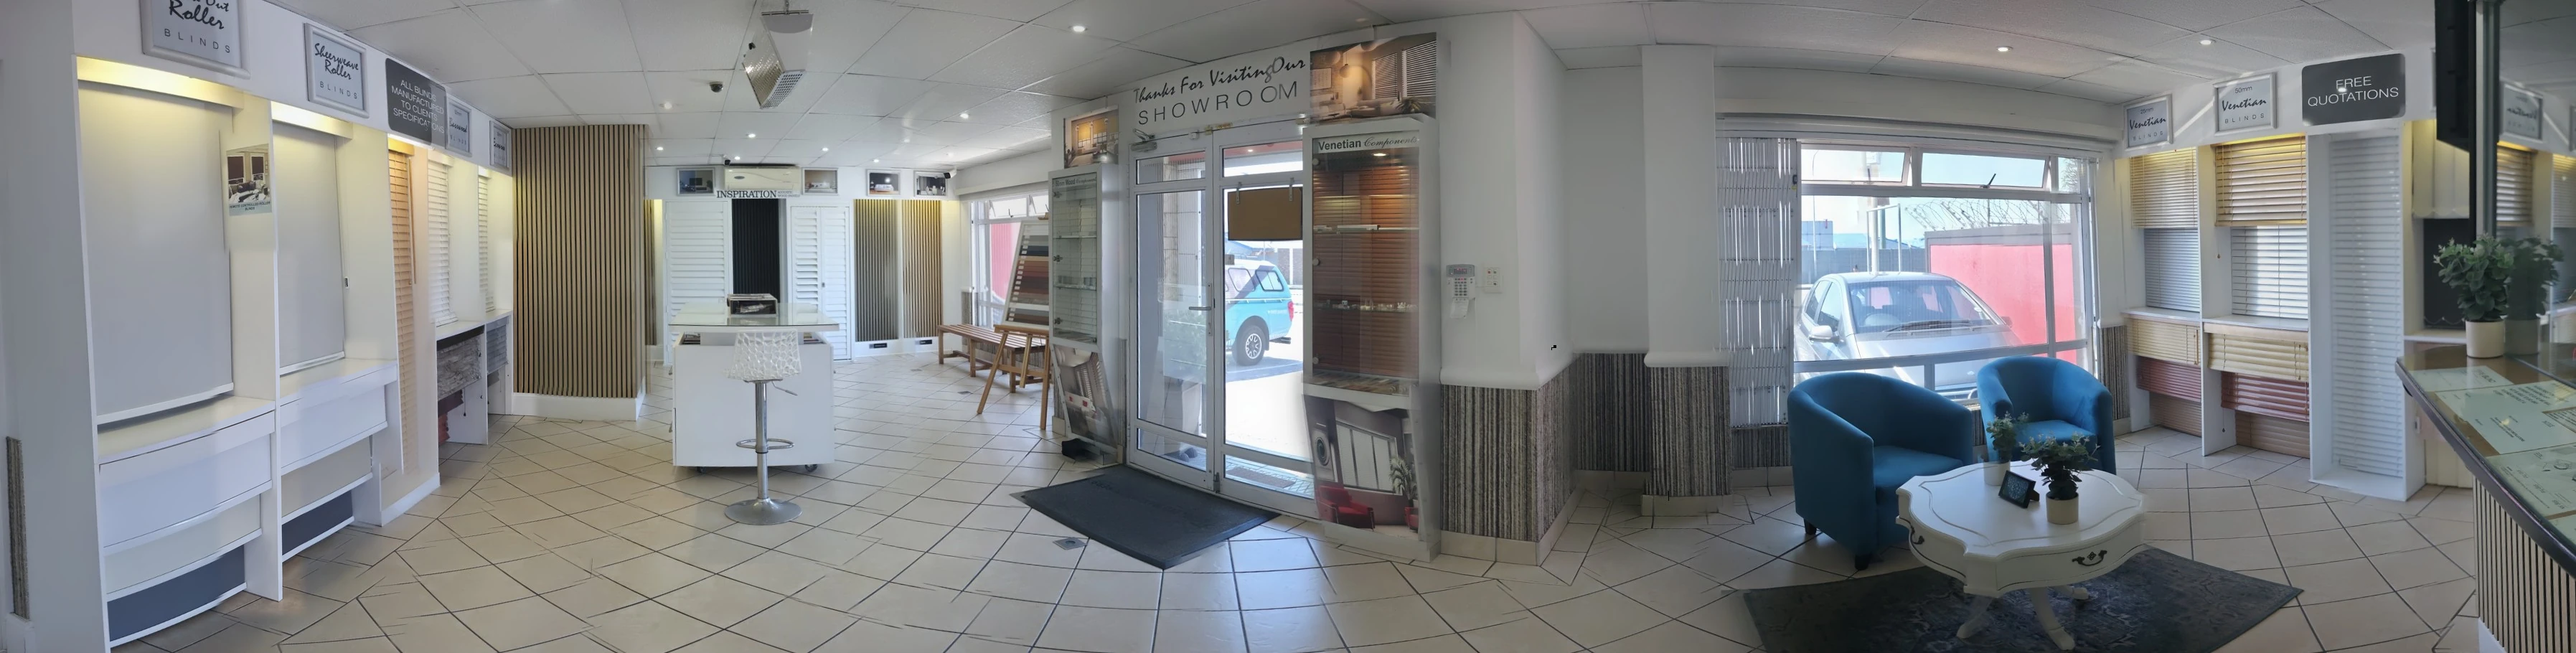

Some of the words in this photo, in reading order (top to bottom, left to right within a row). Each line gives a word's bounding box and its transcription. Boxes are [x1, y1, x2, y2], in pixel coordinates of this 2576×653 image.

[169, 0, 225, 29] Roller
[164, 28, 230, 54] BLINDS
[314, 42, 359, 70] Sheerweave
[324, 58, 352, 80] Roller
[1134, 83, 1175, 104] Thanks
[1180, 76, 1204, 95] For
[1210, 65, 1273, 87] Visiting
[1271, 56, 1306, 75] Our
[319, 80, 358, 100] BLINDS
[400, 80, 413, 92] ALL
[414, 85, 437, 102] BLINDS
[2234, 85, 2253, 94] 50mm
[2336, 75, 2372, 90] FREE
[391, 85, 444, 115] MANUFACTURED
[1138, 80, 1297, 126] SHOWROOM
[2222, 98, 2267, 112] Venetian
[2308, 87, 2399, 107] QUOTATIONS
[393, 108, 445, 134] SPECIFICATONS
[401, 99, 411, 111] TO
[412, 104, 438, 122] CLIENTS
[2224, 112, 2265, 124] BLINDS
[2129, 116, 2166, 131] Venetian
[1318, 139, 1361, 151] Venetian
[1363, 135, 1418, 149] Components
[2133, 131, 2163, 141] BLINDS
